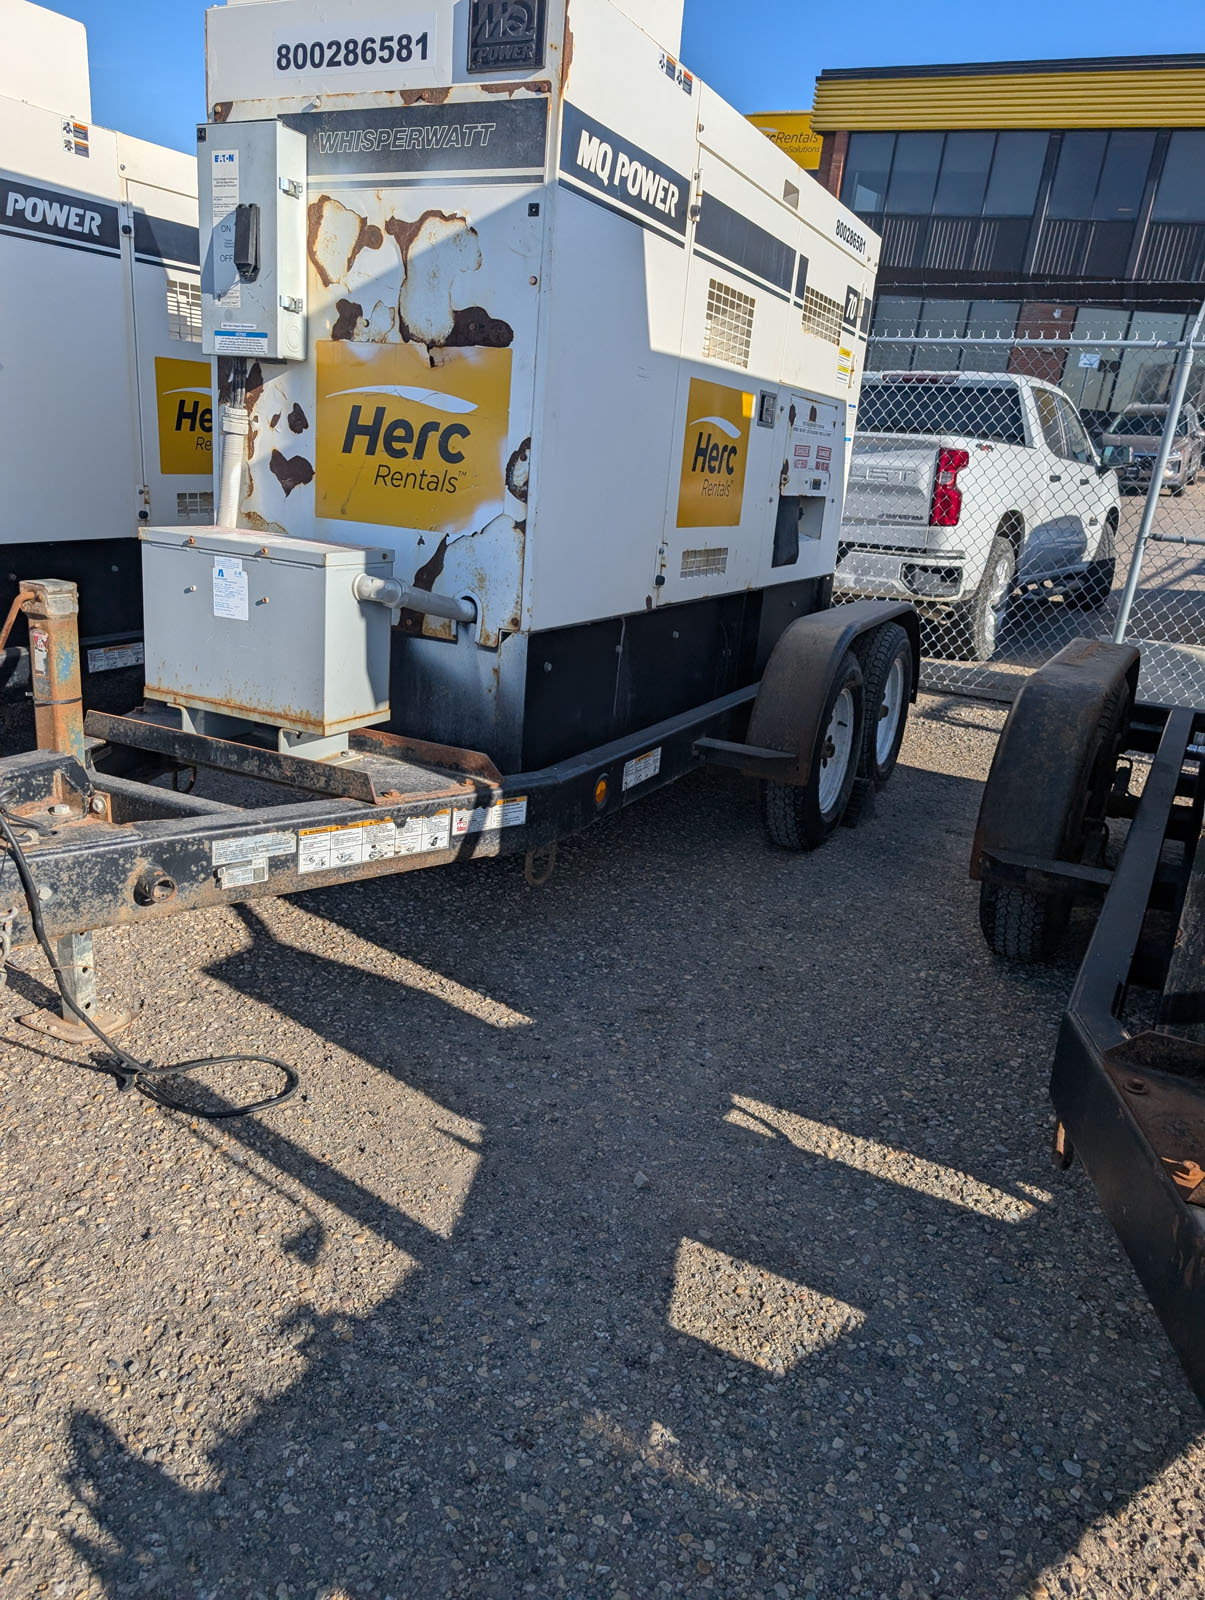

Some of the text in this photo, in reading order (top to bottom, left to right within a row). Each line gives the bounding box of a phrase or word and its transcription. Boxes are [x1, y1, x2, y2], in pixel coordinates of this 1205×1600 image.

[276, 32, 429, 71] 800286581
[318, 123, 496, 153] WHISPERWATT
[577, 129, 679, 218] MQ POWER
[6, 191, 102, 237] POWER
[220, 224, 232, 233] ON
[835, 219, 866, 255] 800286581
[219, 254, 233, 263] OFF
[845, 293, 858, 320] 70
[175, 399, 213, 433] He
[342, 404, 471, 464] Herc
[692, 431, 738, 476] Herc
